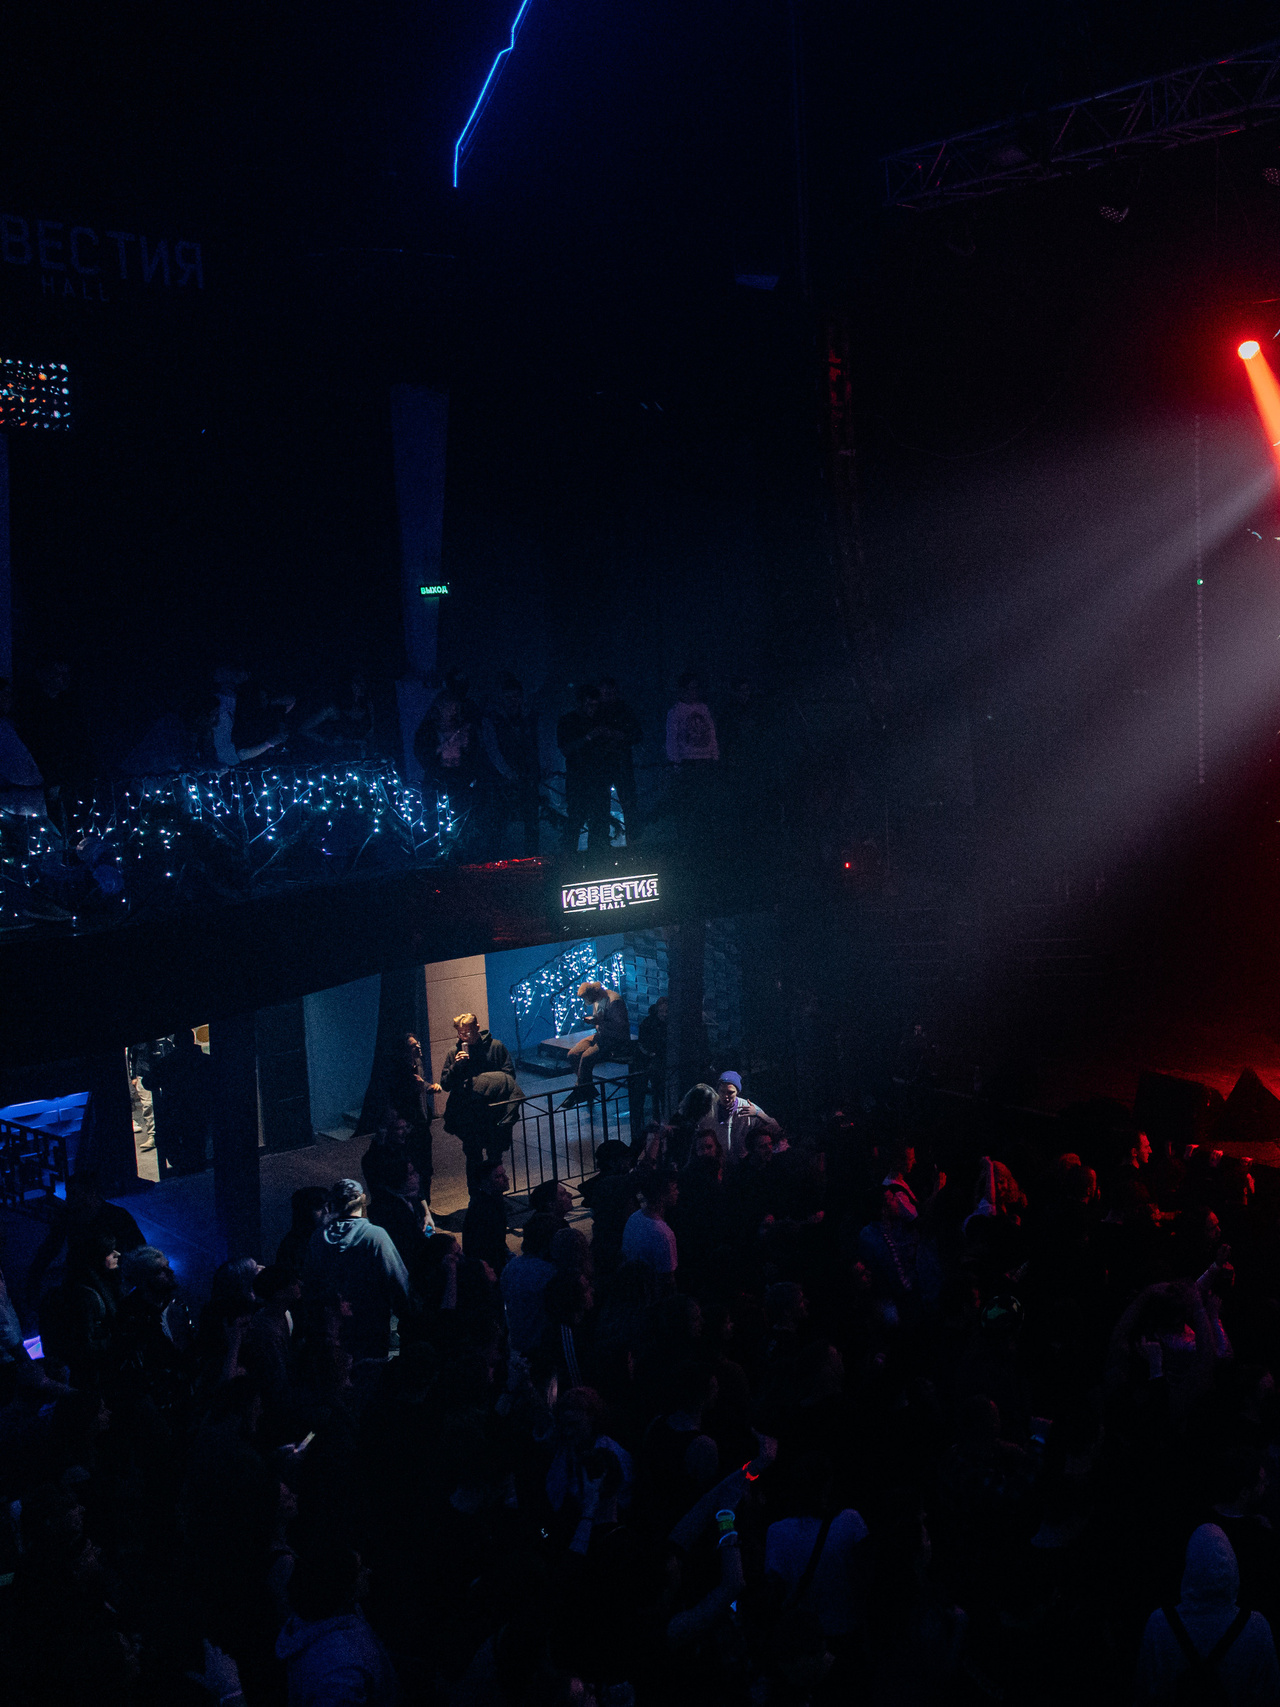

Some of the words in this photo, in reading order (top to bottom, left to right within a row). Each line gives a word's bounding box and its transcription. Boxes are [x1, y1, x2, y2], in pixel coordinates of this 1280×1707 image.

[40, 274, 109, 301] HALL
[420, 585, 448, 595] ВЫХОД
[562, 878, 659, 908] ИЗВЕСТИЯ
[599, 901, 626, 911] HALL
